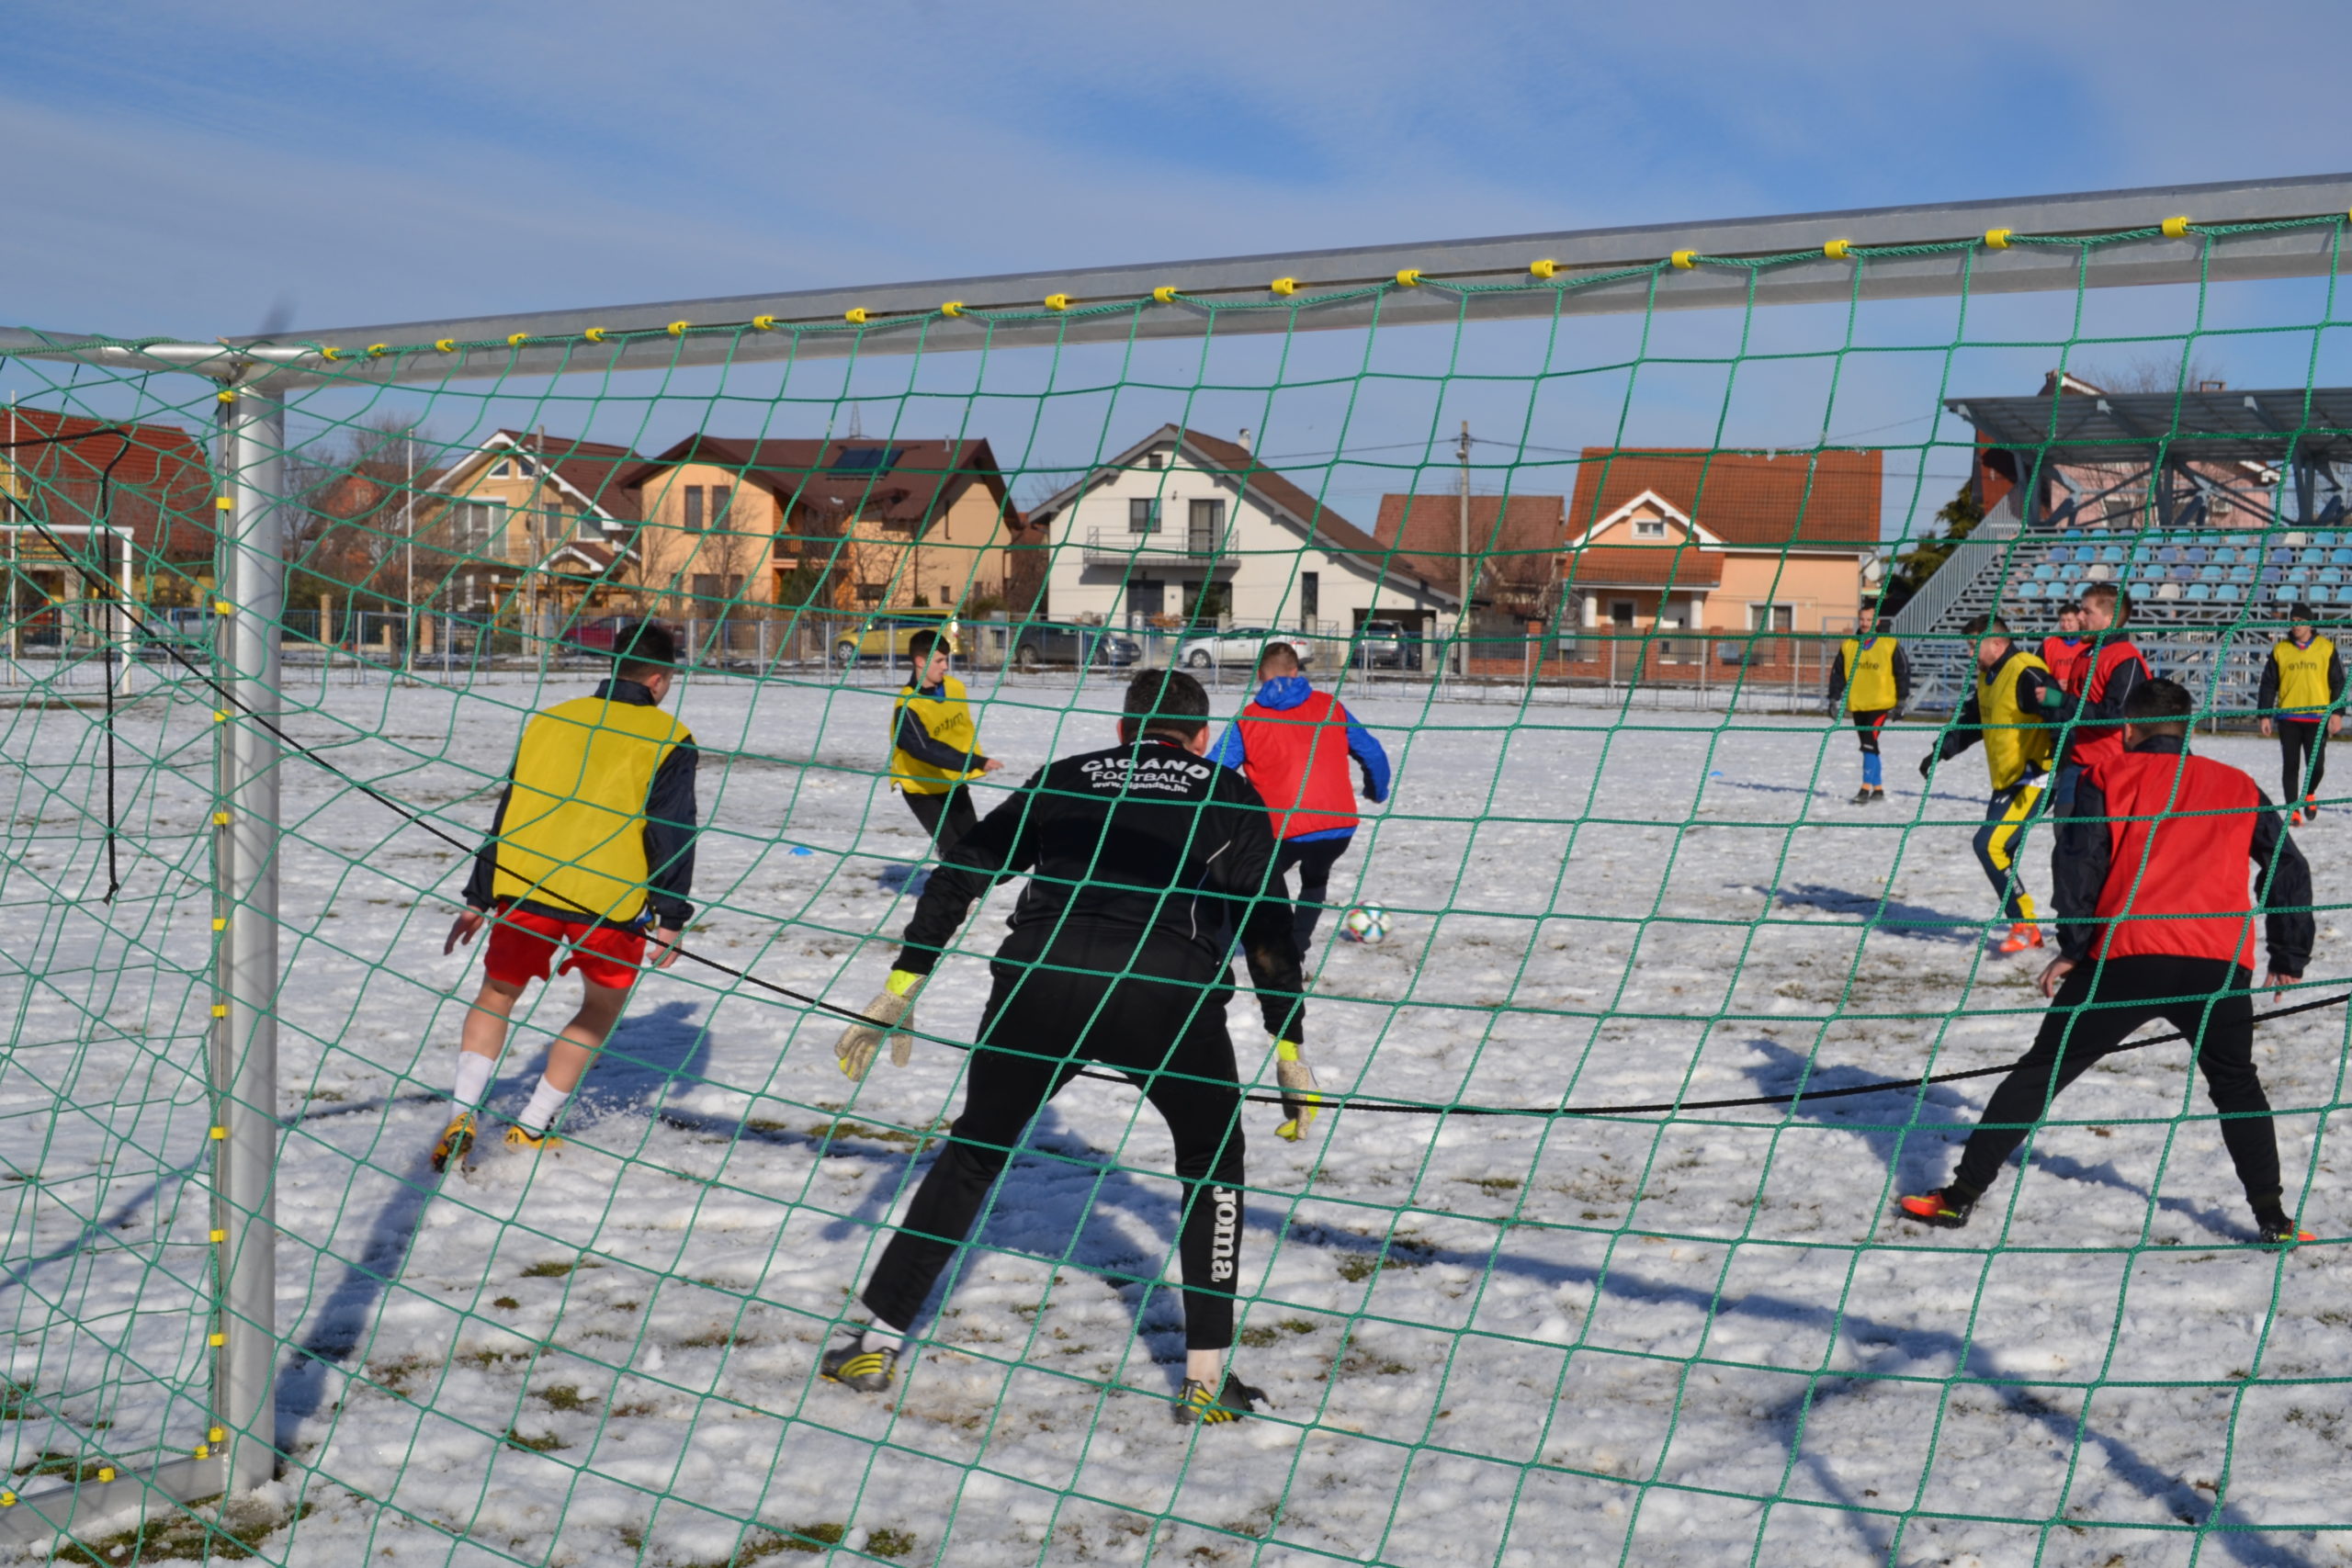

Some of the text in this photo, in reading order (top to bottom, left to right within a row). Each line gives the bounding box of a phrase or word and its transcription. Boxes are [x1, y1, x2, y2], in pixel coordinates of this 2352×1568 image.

[1080, 758, 1211, 780] GIGÁND
[1091, 771, 1192, 787] FOOTBALL
[1211, 1186, 1237, 1282] Joma
